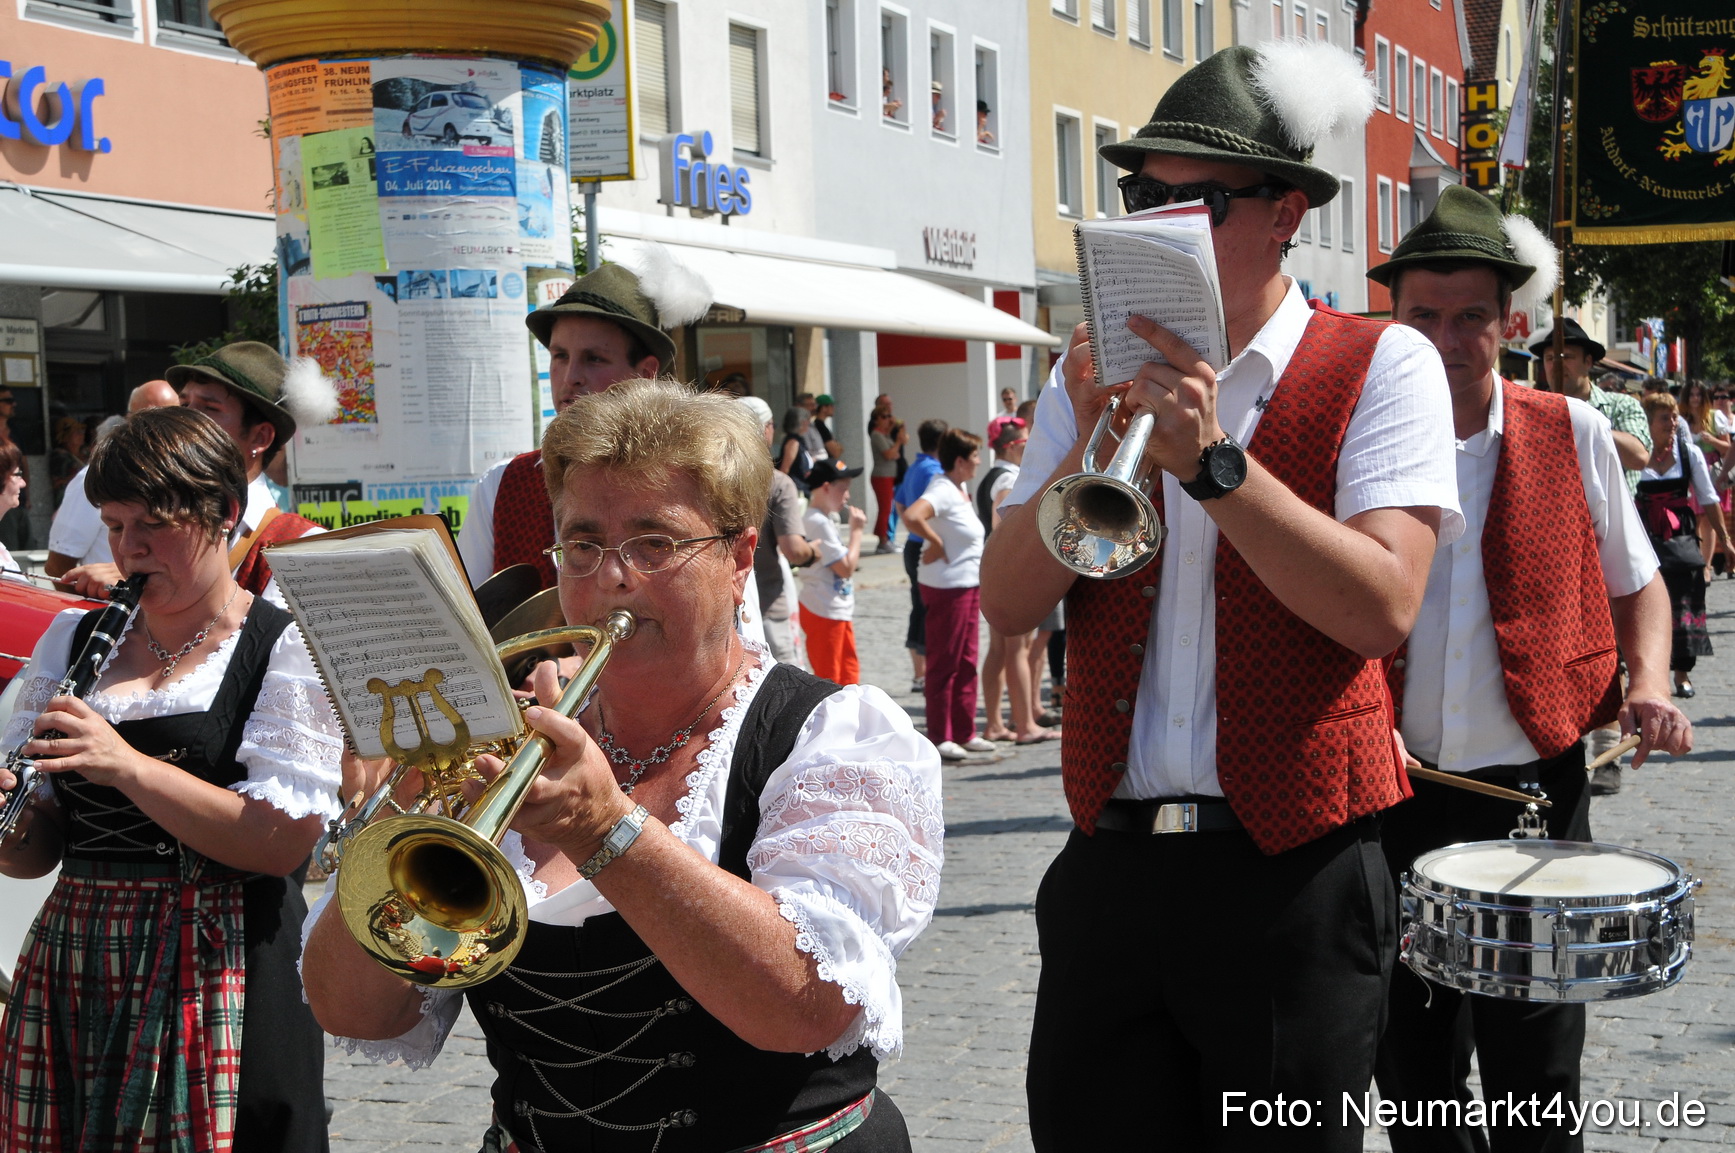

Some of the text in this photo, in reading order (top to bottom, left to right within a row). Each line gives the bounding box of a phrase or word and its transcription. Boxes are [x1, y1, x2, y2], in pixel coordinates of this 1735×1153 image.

[569, 87, 614, 99] arktplatz
[673, 130, 752, 216] fries
[404, 180, 424, 190] Juli
[426, 180, 452, 190] 2014
[453, 246, 505, 255] NEUMARKT
